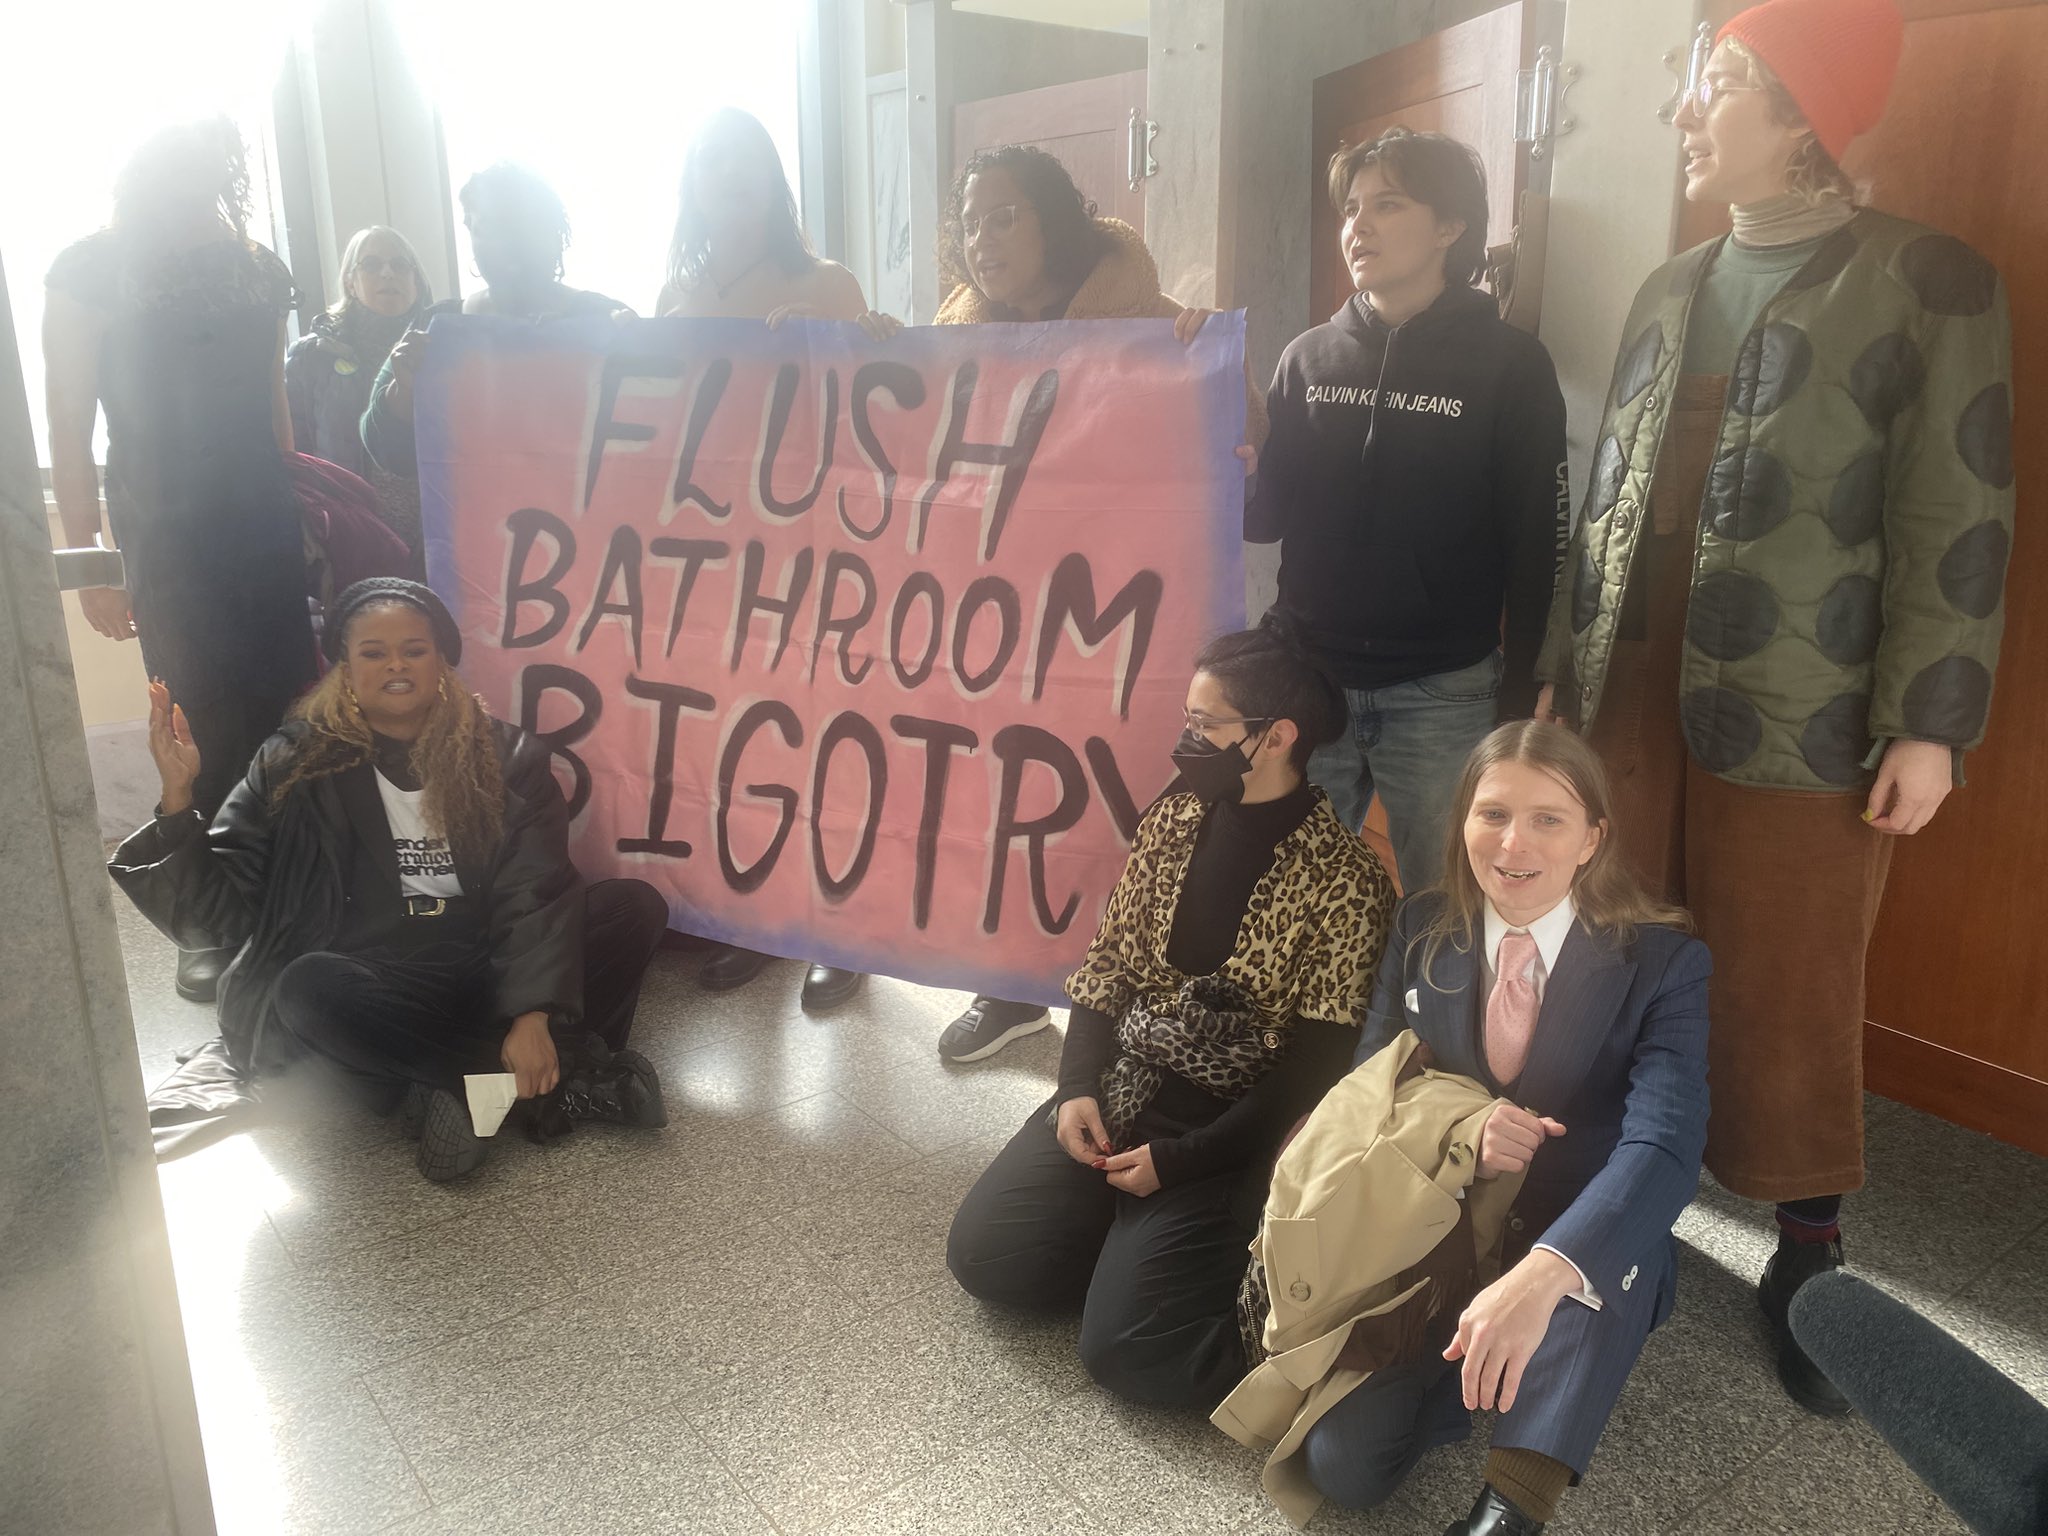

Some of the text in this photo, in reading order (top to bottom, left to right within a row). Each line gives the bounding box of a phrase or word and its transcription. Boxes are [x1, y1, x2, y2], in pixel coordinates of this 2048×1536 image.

[581, 360, 1060, 561] FLUSH
[1305, 385, 1464, 419] CALVIN KLIN JEANS
[500, 508, 1165, 722] BATHROOM
[396, 850, 453, 865] ration
